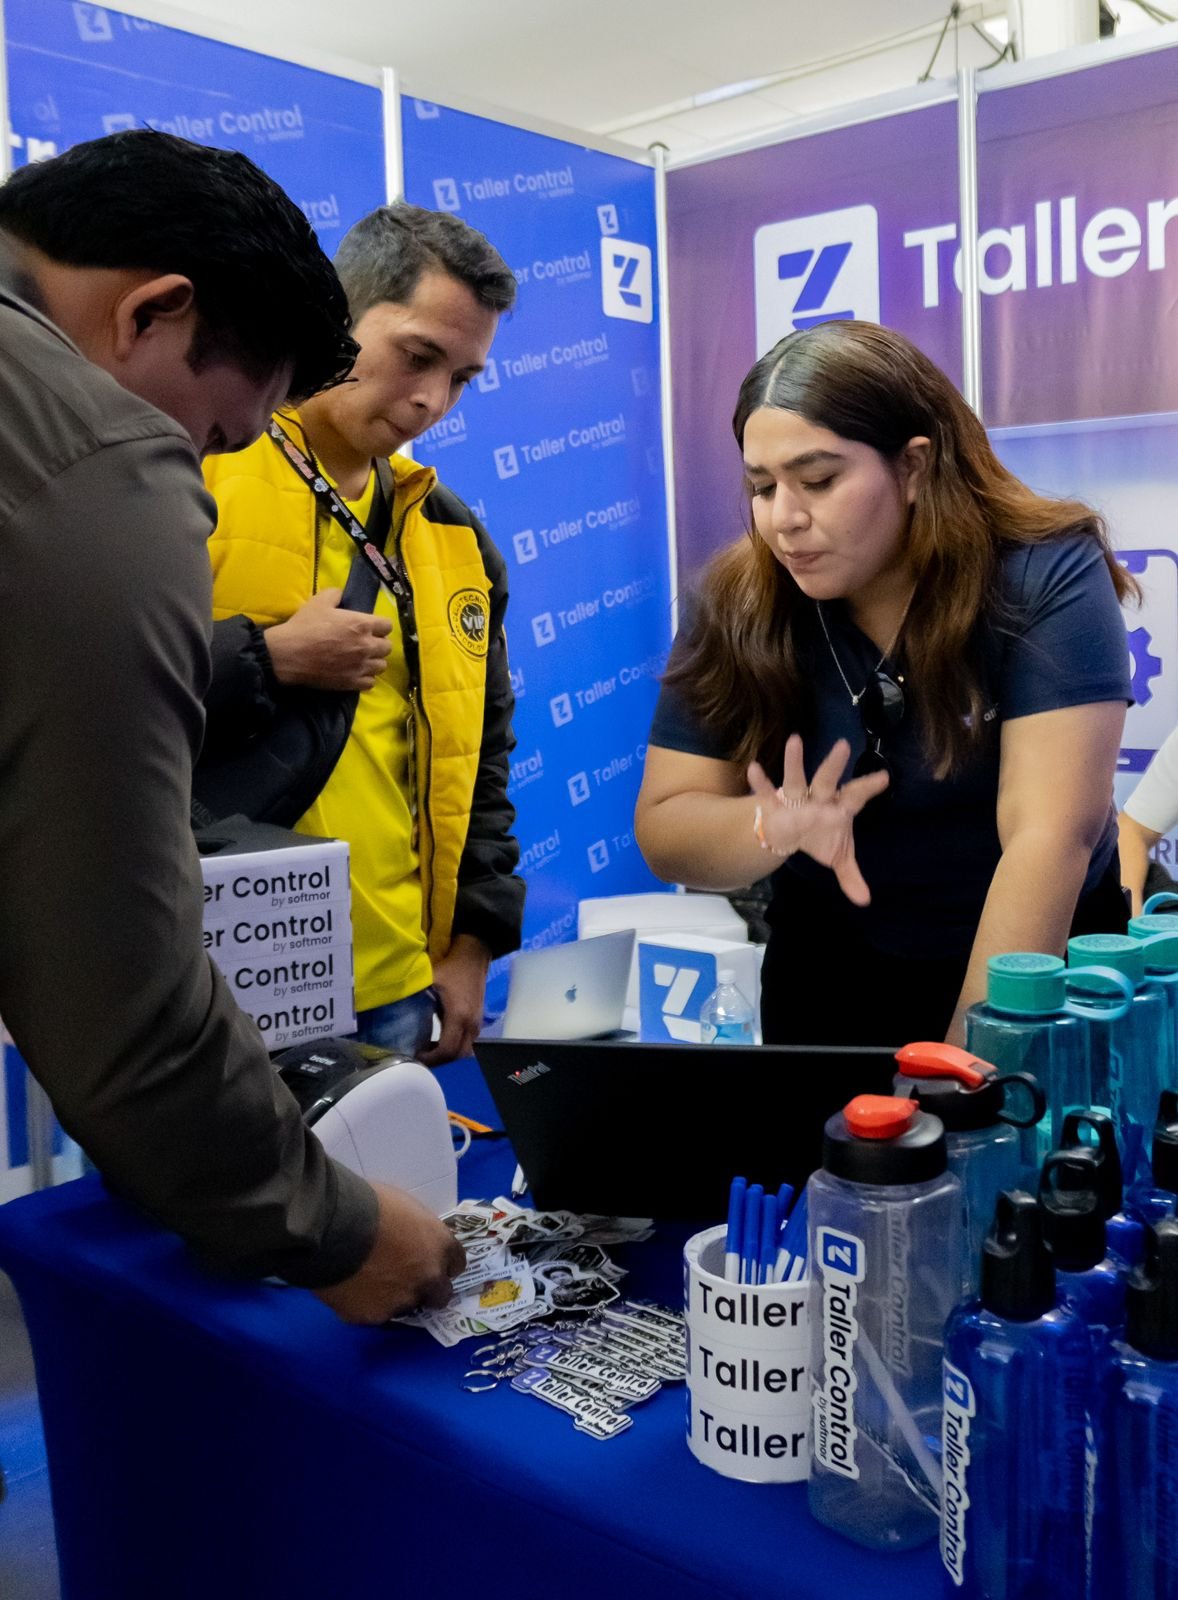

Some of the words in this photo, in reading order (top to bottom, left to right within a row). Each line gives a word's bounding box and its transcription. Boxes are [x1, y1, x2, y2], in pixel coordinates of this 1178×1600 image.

[218, 105, 302, 133] Control
[462, 179, 510, 201] Taller
[513, 166, 573, 193] Control
[532, 250, 591, 280] Control
[502, 353, 548, 379] Taller
[551, 333, 608, 365] Control
[521, 437, 566, 464] Taller
[568, 414, 625, 447] Control
[539, 519, 582, 548] Taller
[462, 615, 485, 630] VIP
[558, 599, 599, 629] Taller
[575, 677, 617, 708] Taller
[593, 754, 633, 786] Taller
[232, 865, 330, 898] Control
[272, 897, 286, 908] by
[288, 891, 331, 904] softmor
[233, 909, 332, 944] Control
[273, 942, 287, 952] by
[289, 935, 333, 949] softmor
[235, 953, 333, 989] Control
[274, 986, 287, 997] by
[291, 980, 333, 993] softmor
[250, 997, 334, 1031] ontrol
[275, 1032, 289, 1042] by
[292, 1023, 334, 1038] softmor
[699, 1281, 804, 1328] Taller
[830, 1284, 851, 1361] Taller
[553, 1349, 596, 1373] Taller
[599, 1366, 656, 1390] Control
[699, 1345, 805, 1393] Taller
[537, 1377, 574, 1401] Taller
[574, 1397, 629, 1428] Control
[817, 1397, 828, 1413] by
[830, 1365, 853, 1472] Control
[700, 1409, 805, 1459] Taller
[820, 1414, 829, 1461] softmor
[946, 1410, 962, 1479] Taller
[945, 1480, 961, 1577] Control
